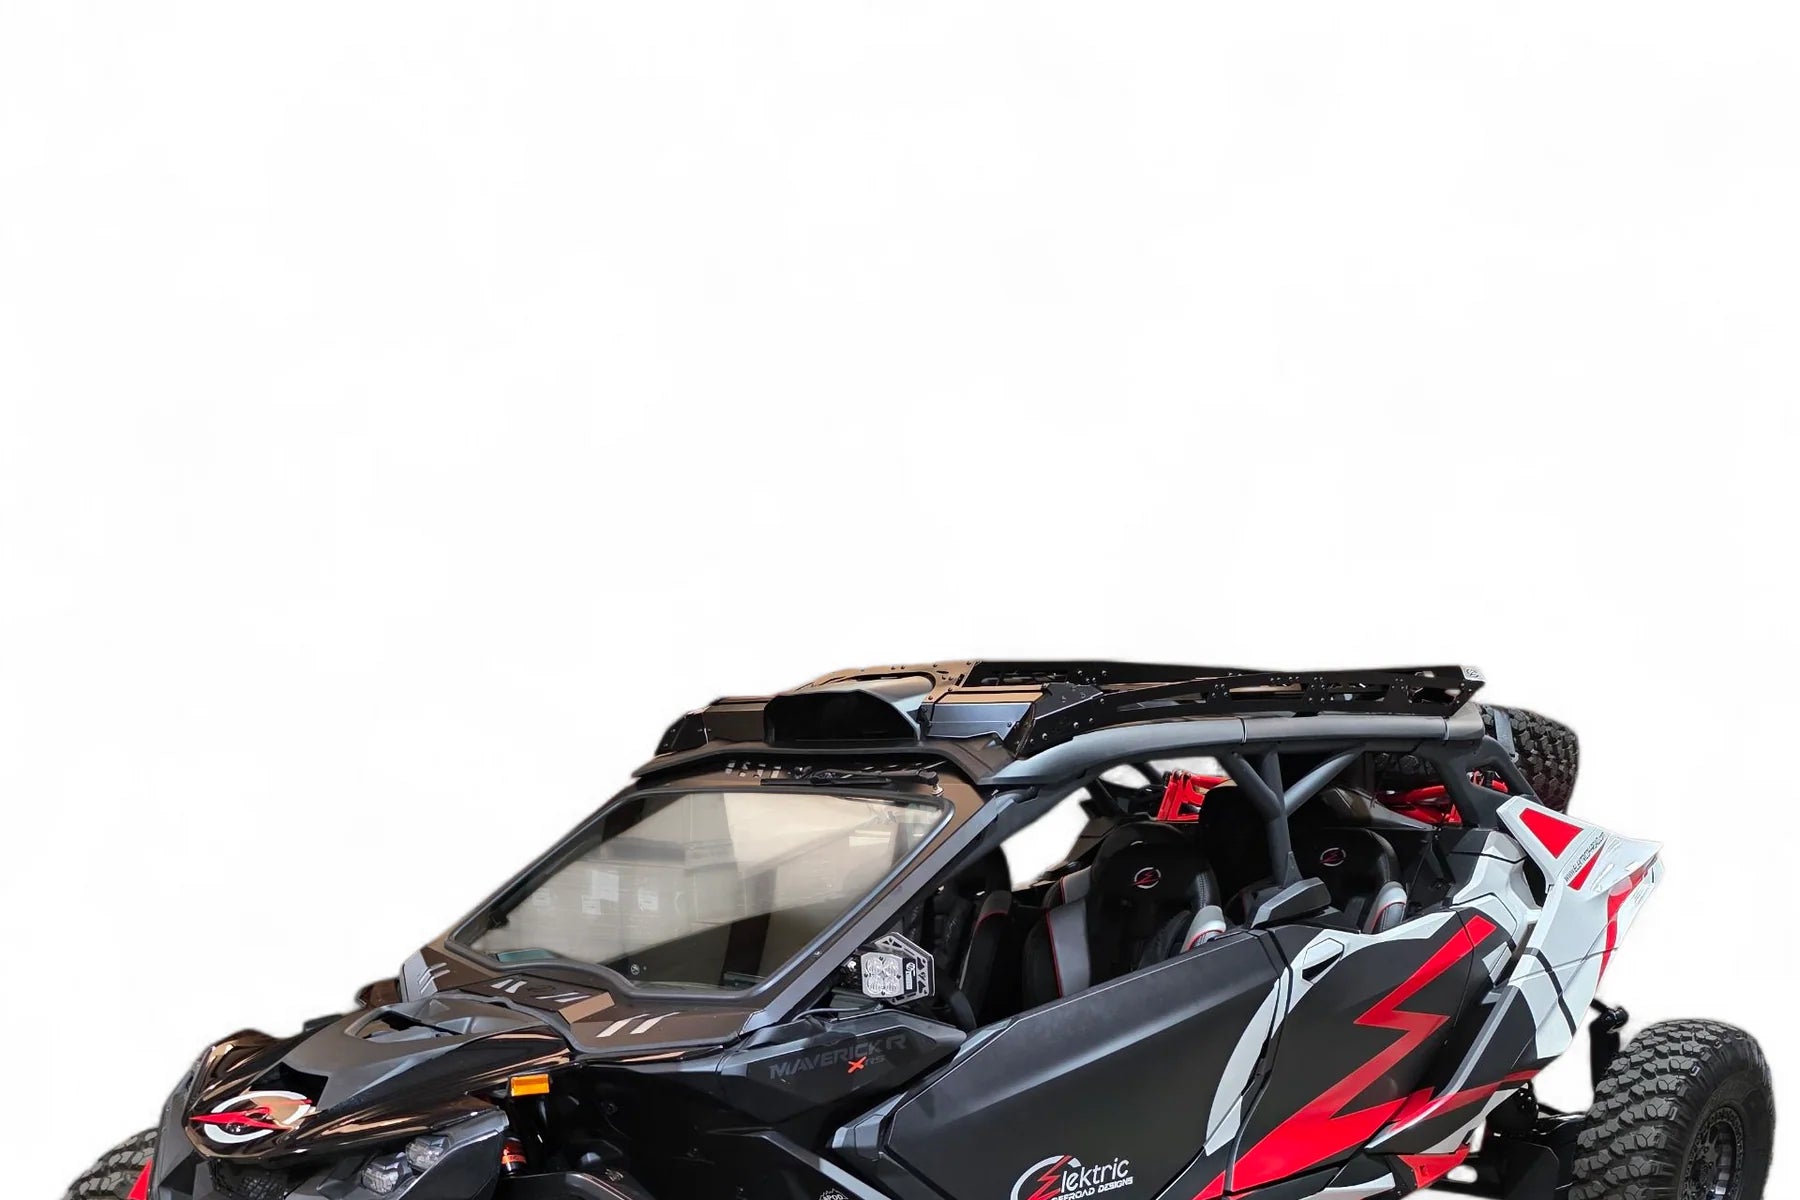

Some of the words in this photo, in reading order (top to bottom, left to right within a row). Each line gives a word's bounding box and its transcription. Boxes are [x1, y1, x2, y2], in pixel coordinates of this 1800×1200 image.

[768, 1040, 884, 1080] MAVERICK
[884, 1034, 907, 1051] R
[1097, 1176, 1134, 1193] DESIGNS
